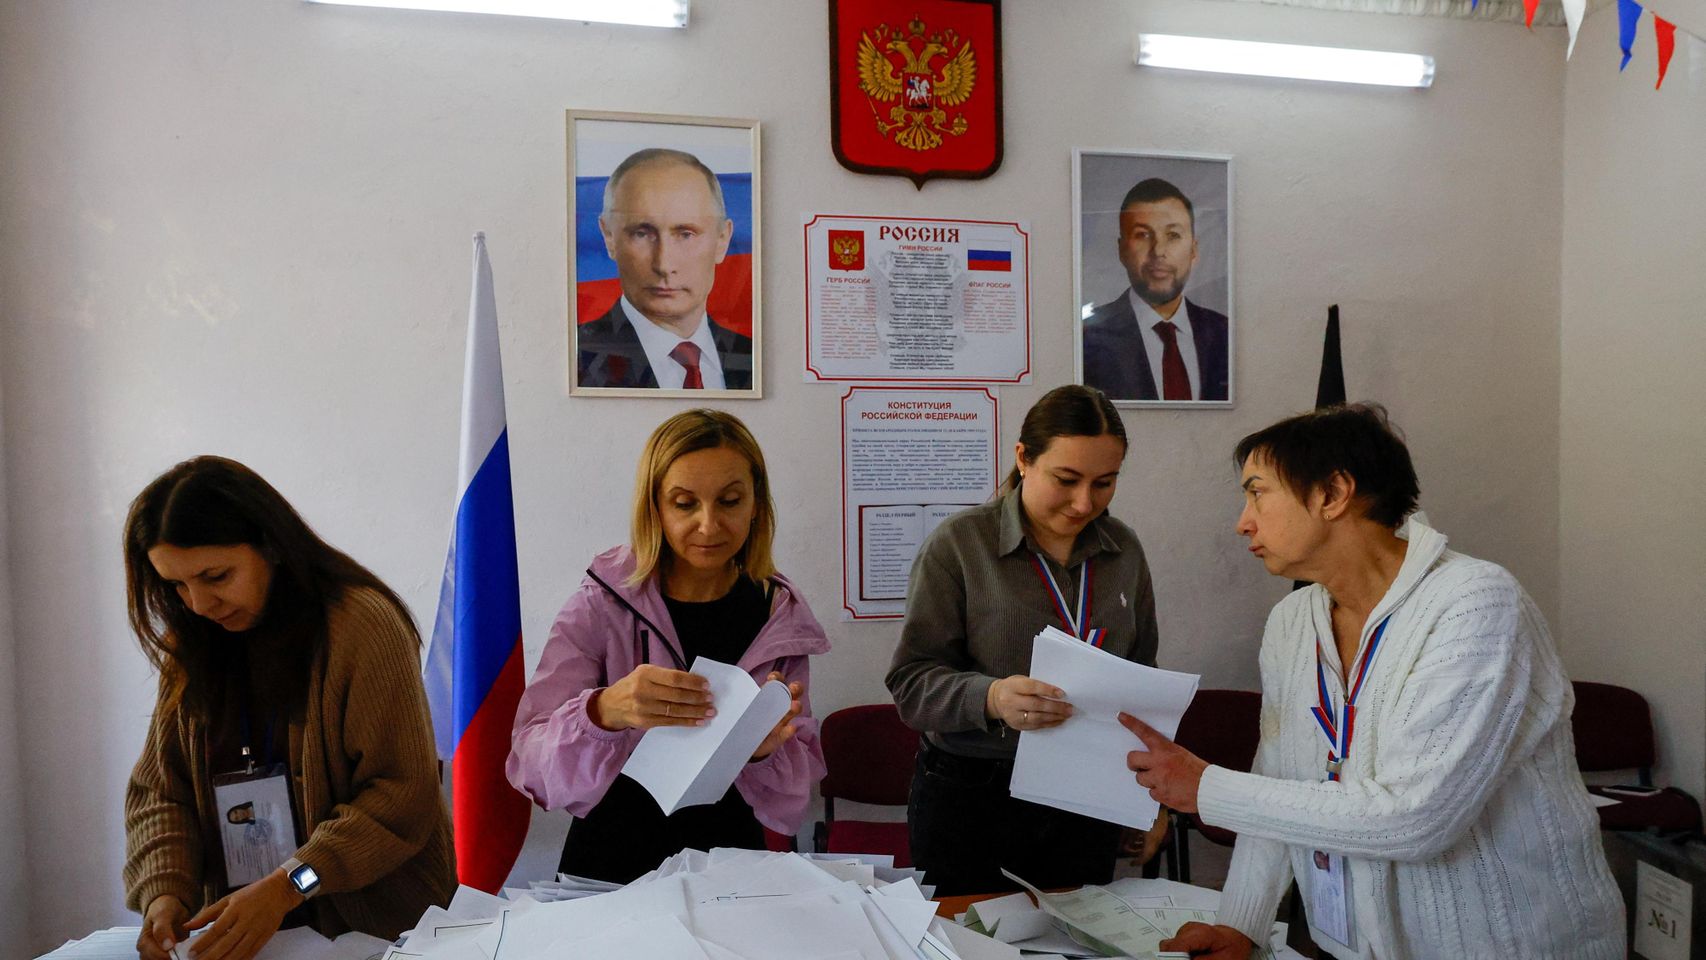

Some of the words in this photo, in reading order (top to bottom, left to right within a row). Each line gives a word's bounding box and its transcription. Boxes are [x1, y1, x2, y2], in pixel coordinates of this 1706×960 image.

[879, 225, 960, 243] РОССИЯ
[986, 281, 1012, 289] РОССИИ
[888, 401, 952, 411] КОНСТИТУЦИЯ
[861, 410, 922, 420] РОССИЙСКОЙ
[924, 412, 978, 421] ФЕДЕРАЦИИ
